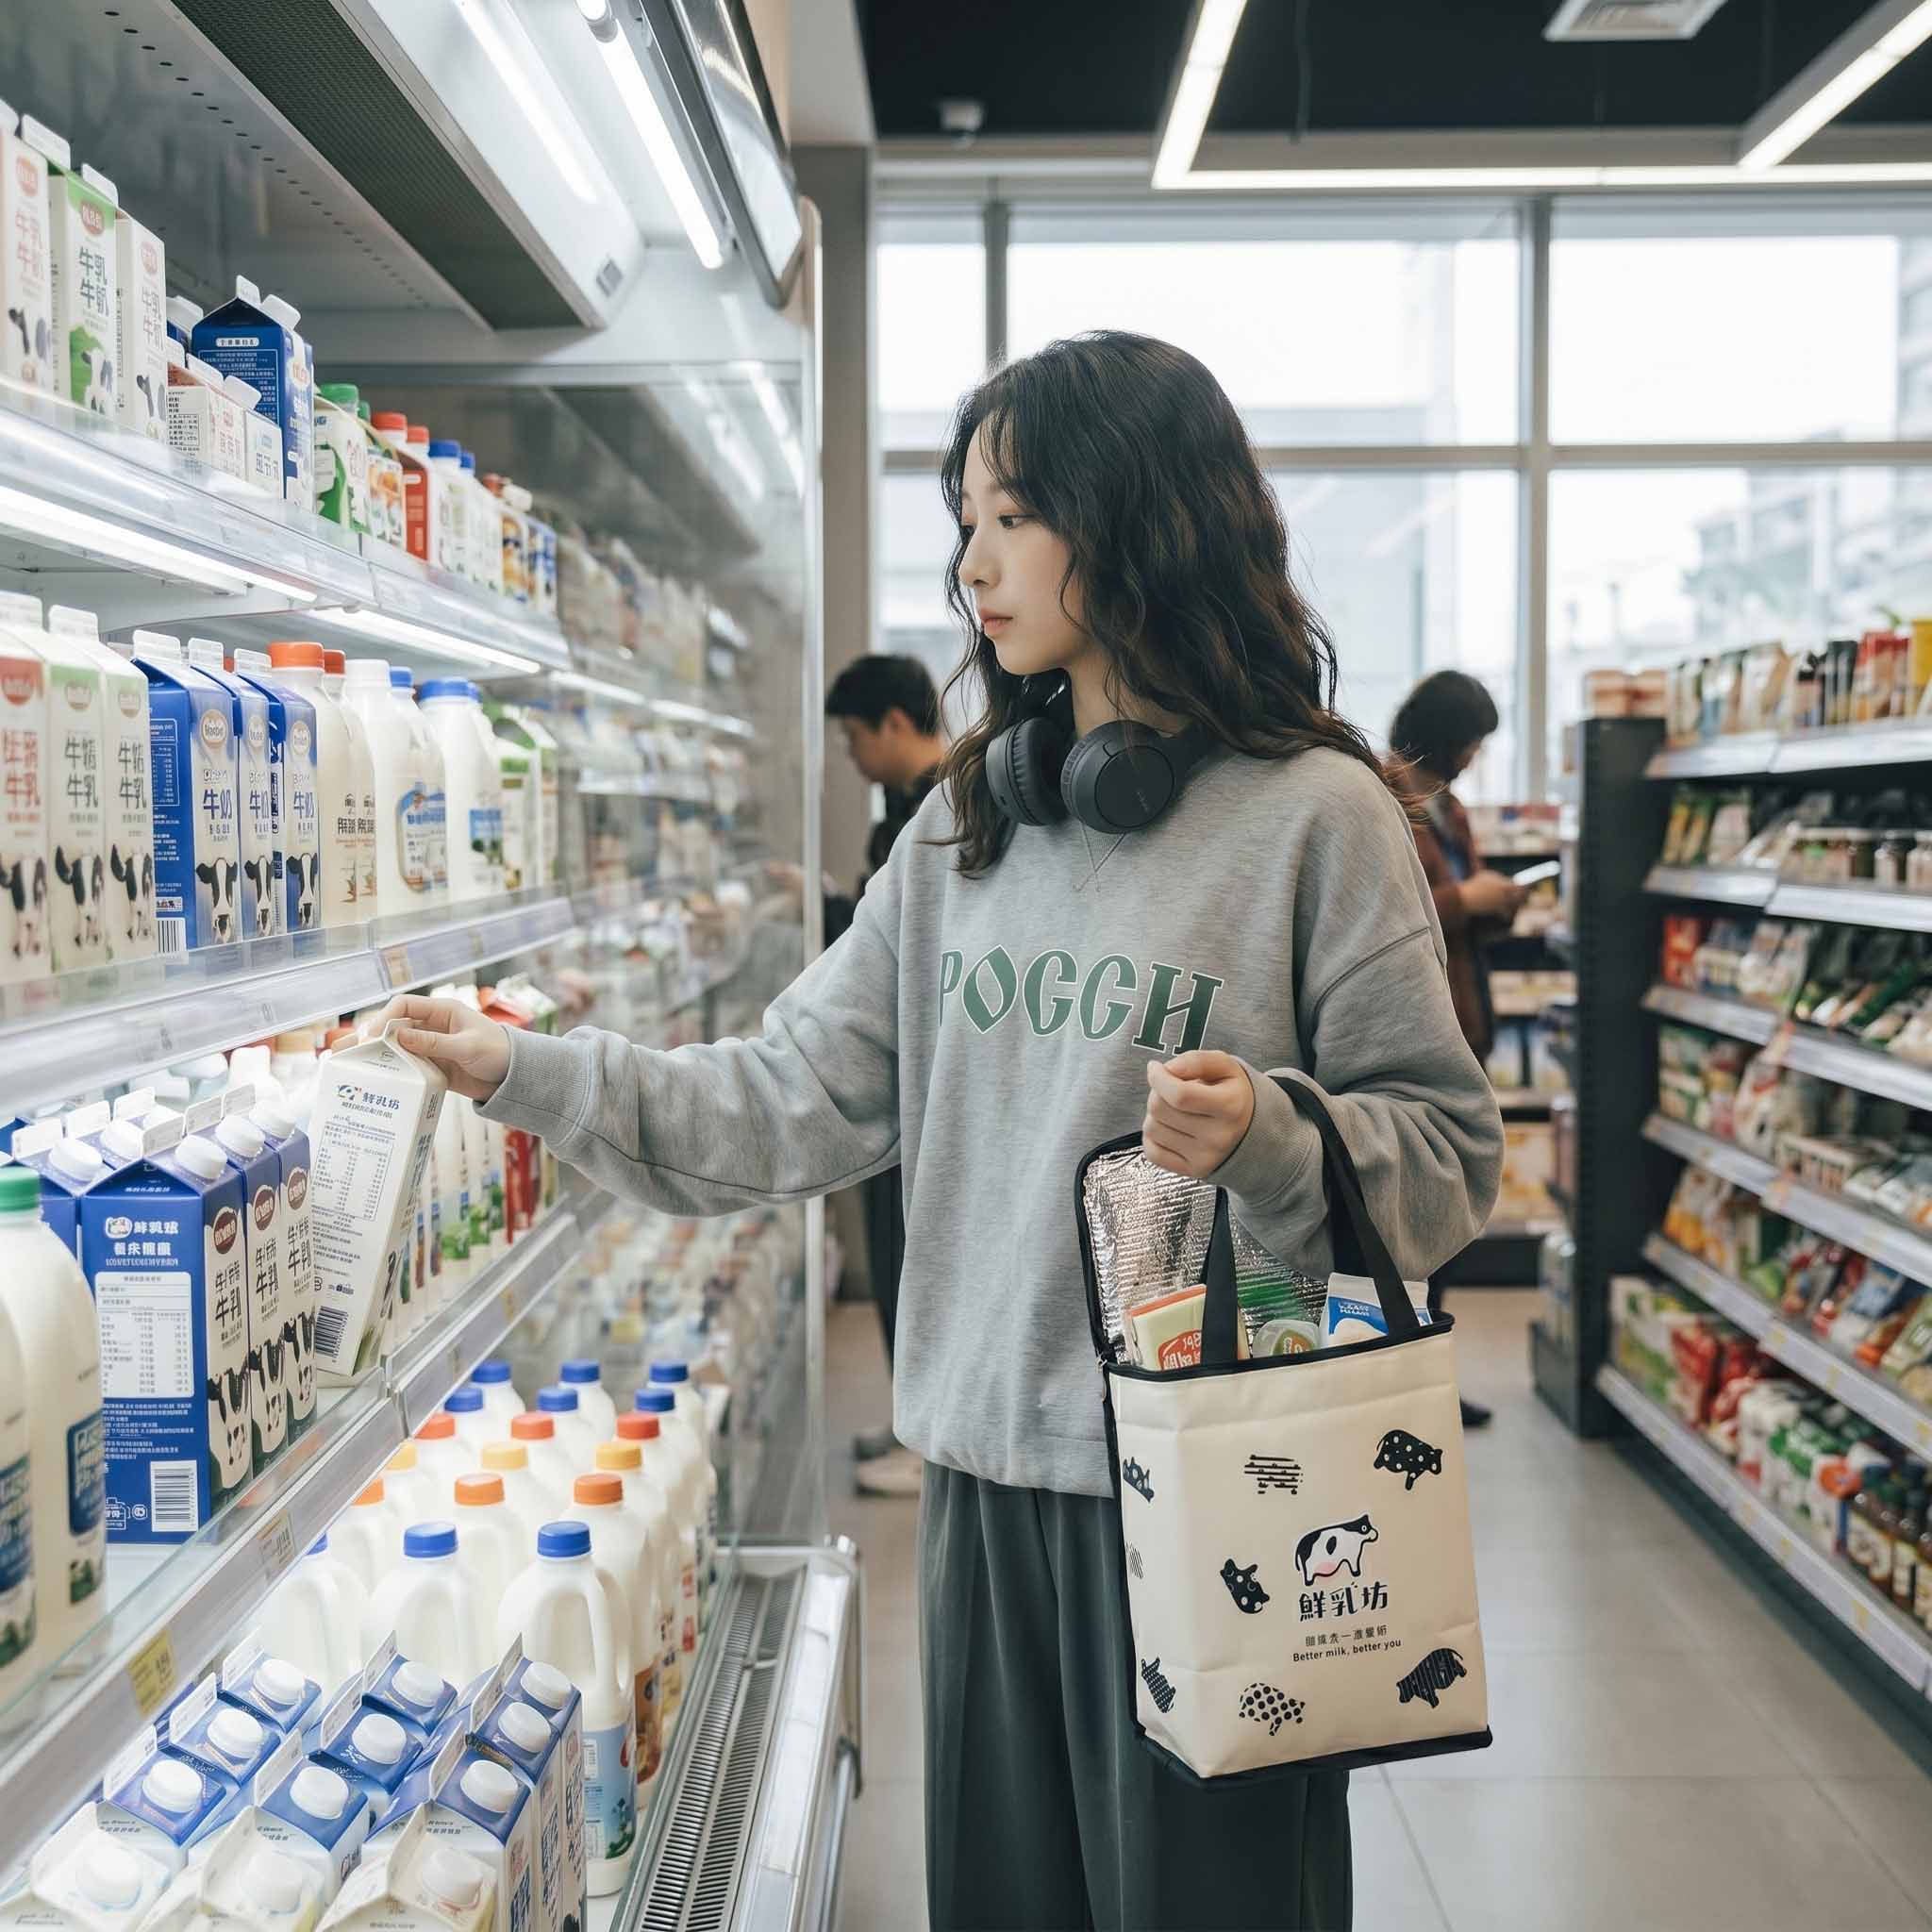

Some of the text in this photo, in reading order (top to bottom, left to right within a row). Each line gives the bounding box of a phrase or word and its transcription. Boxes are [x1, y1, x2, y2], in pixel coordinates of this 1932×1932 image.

[67, 773, 99, 808] 牛乳
[119, 776, 147, 809] 牛乳
[1299, 1581, 1388, 1622] 鮮乳坊
[1292, 1640, 1402, 1662] Better milk, better you
